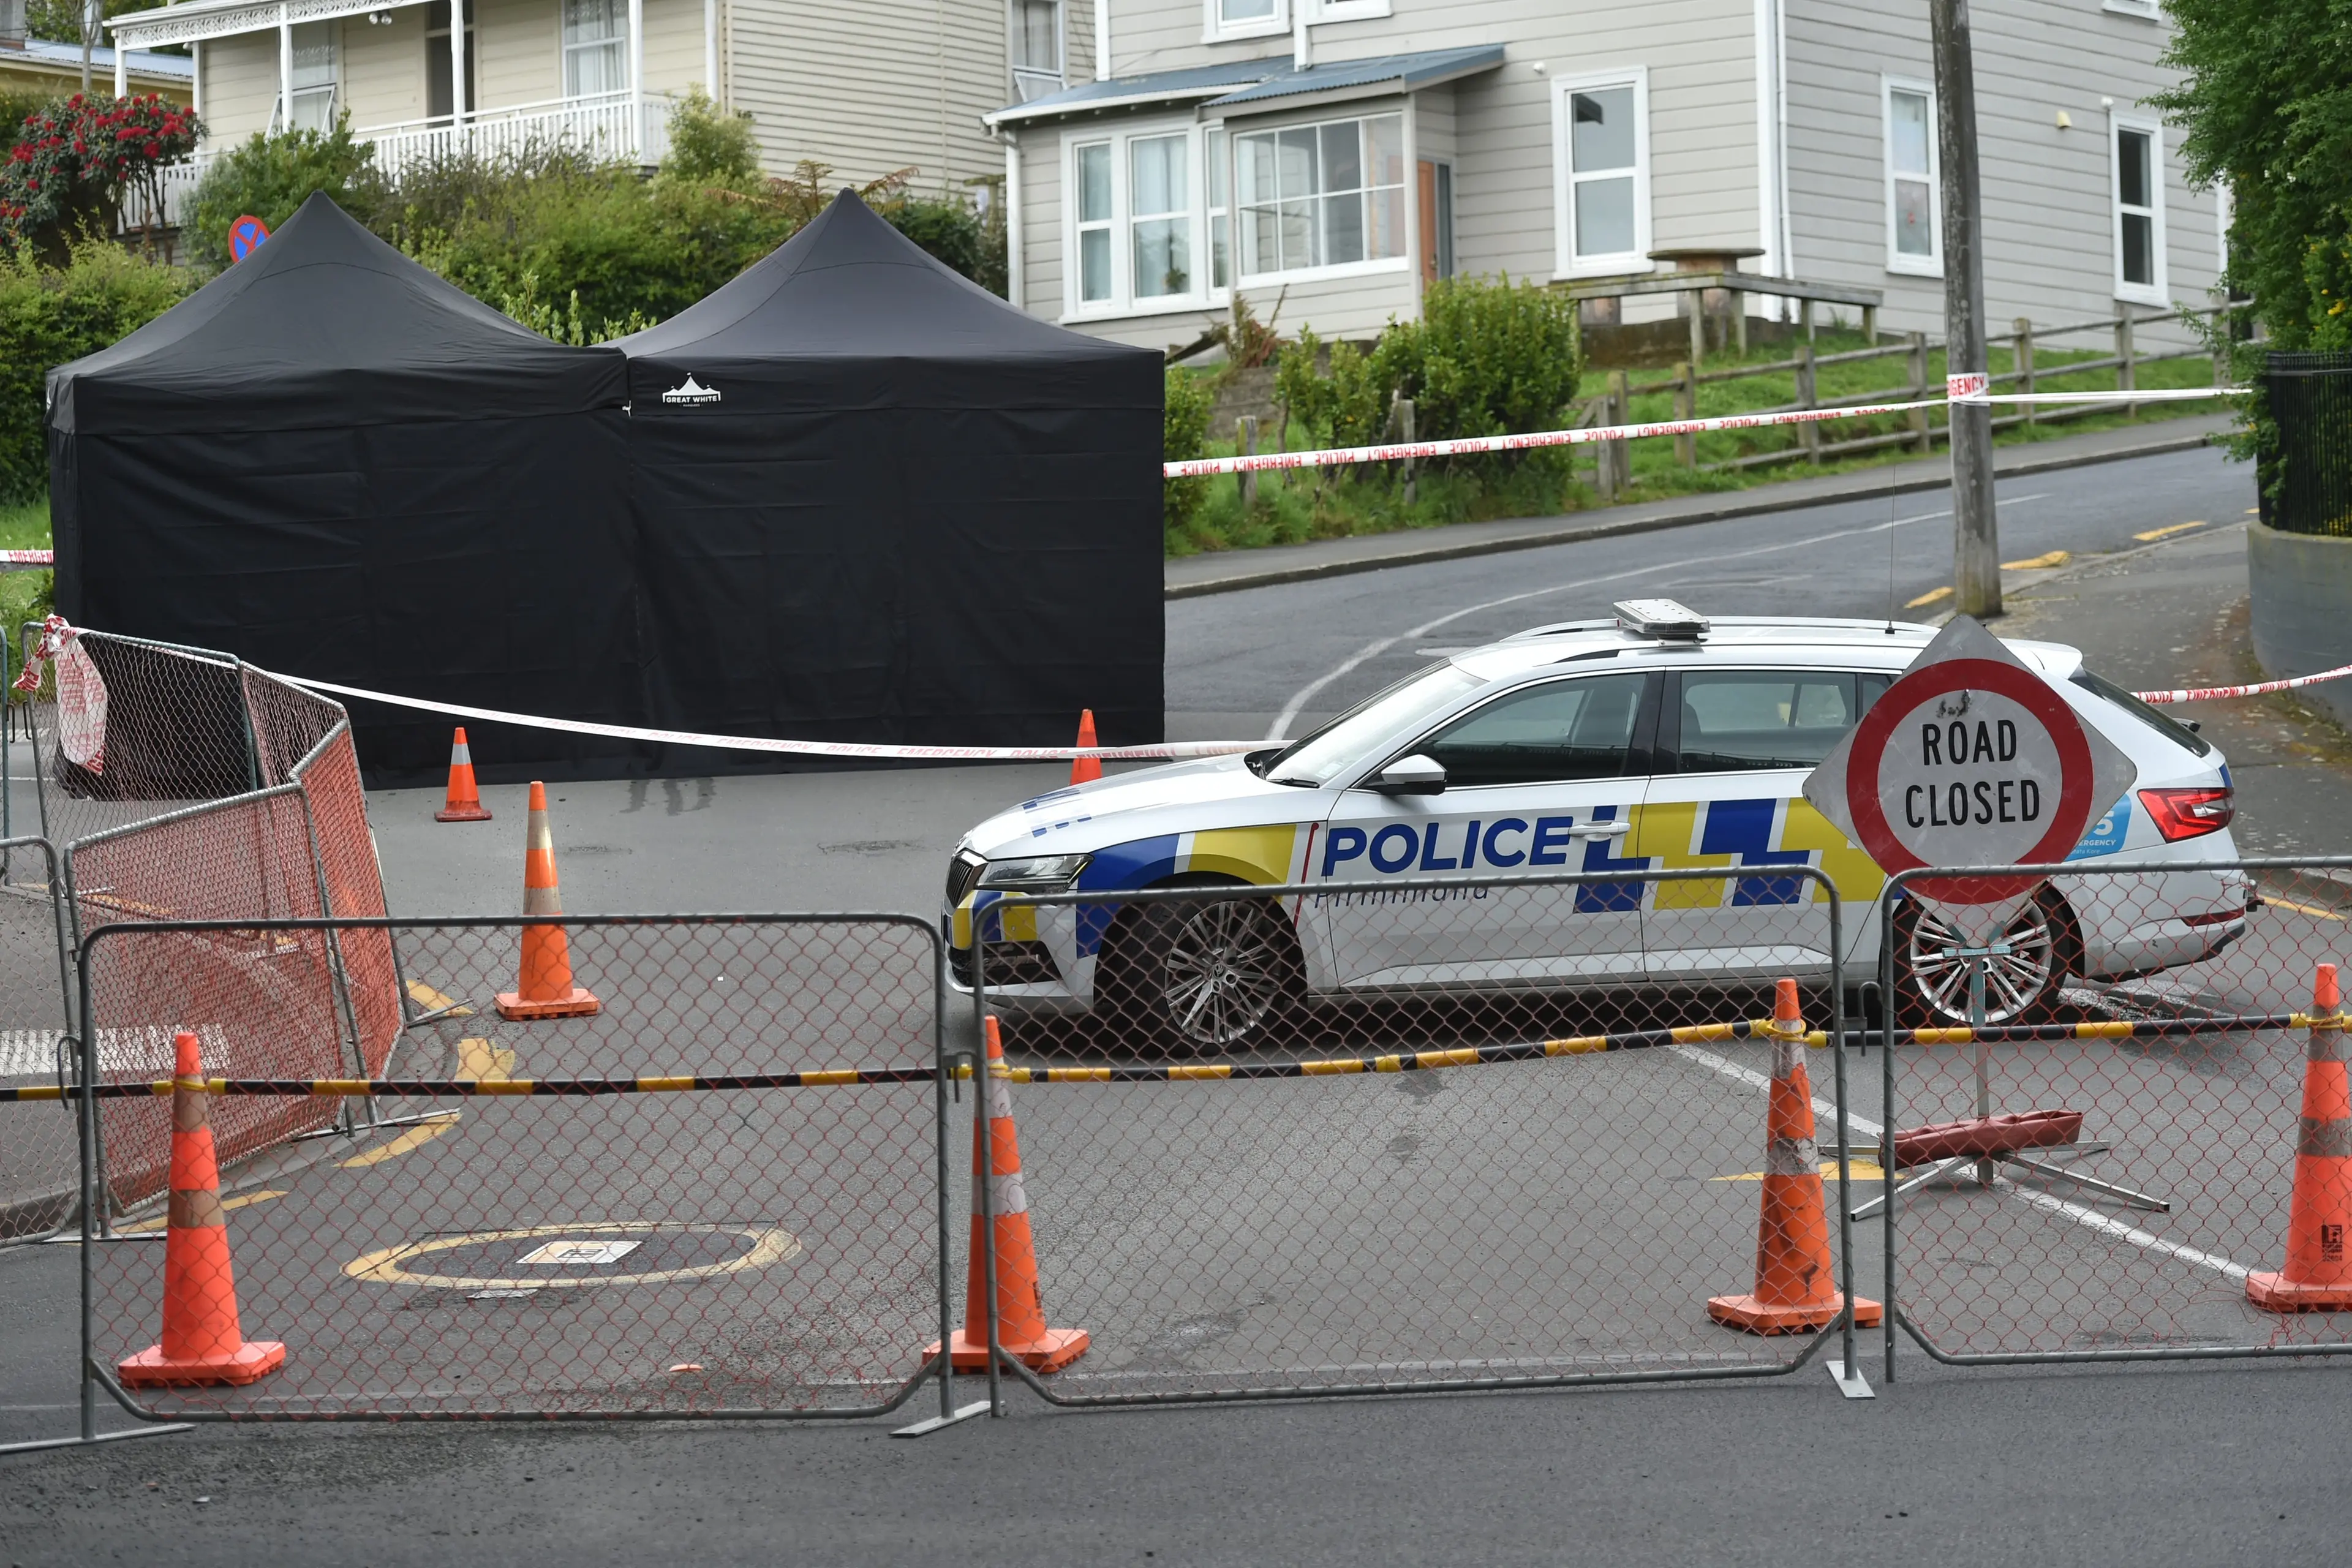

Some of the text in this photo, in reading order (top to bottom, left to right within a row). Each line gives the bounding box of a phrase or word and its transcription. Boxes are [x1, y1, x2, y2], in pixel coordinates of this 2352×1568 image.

[1367, 445, 1437, 461] EMERGENCY
[1450, 441, 1489, 454] POLICE
[1233, 455, 1302, 472] EMERGENCY
[1316, 451, 1354, 466] POLICE
[1180, 461, 1220, 476] POLICE
[1922, 720, 2017, 766] ROAD
[1905, 780, 2040, 828] CLOSED
[1321, 816, 1574, 877] POLICE
